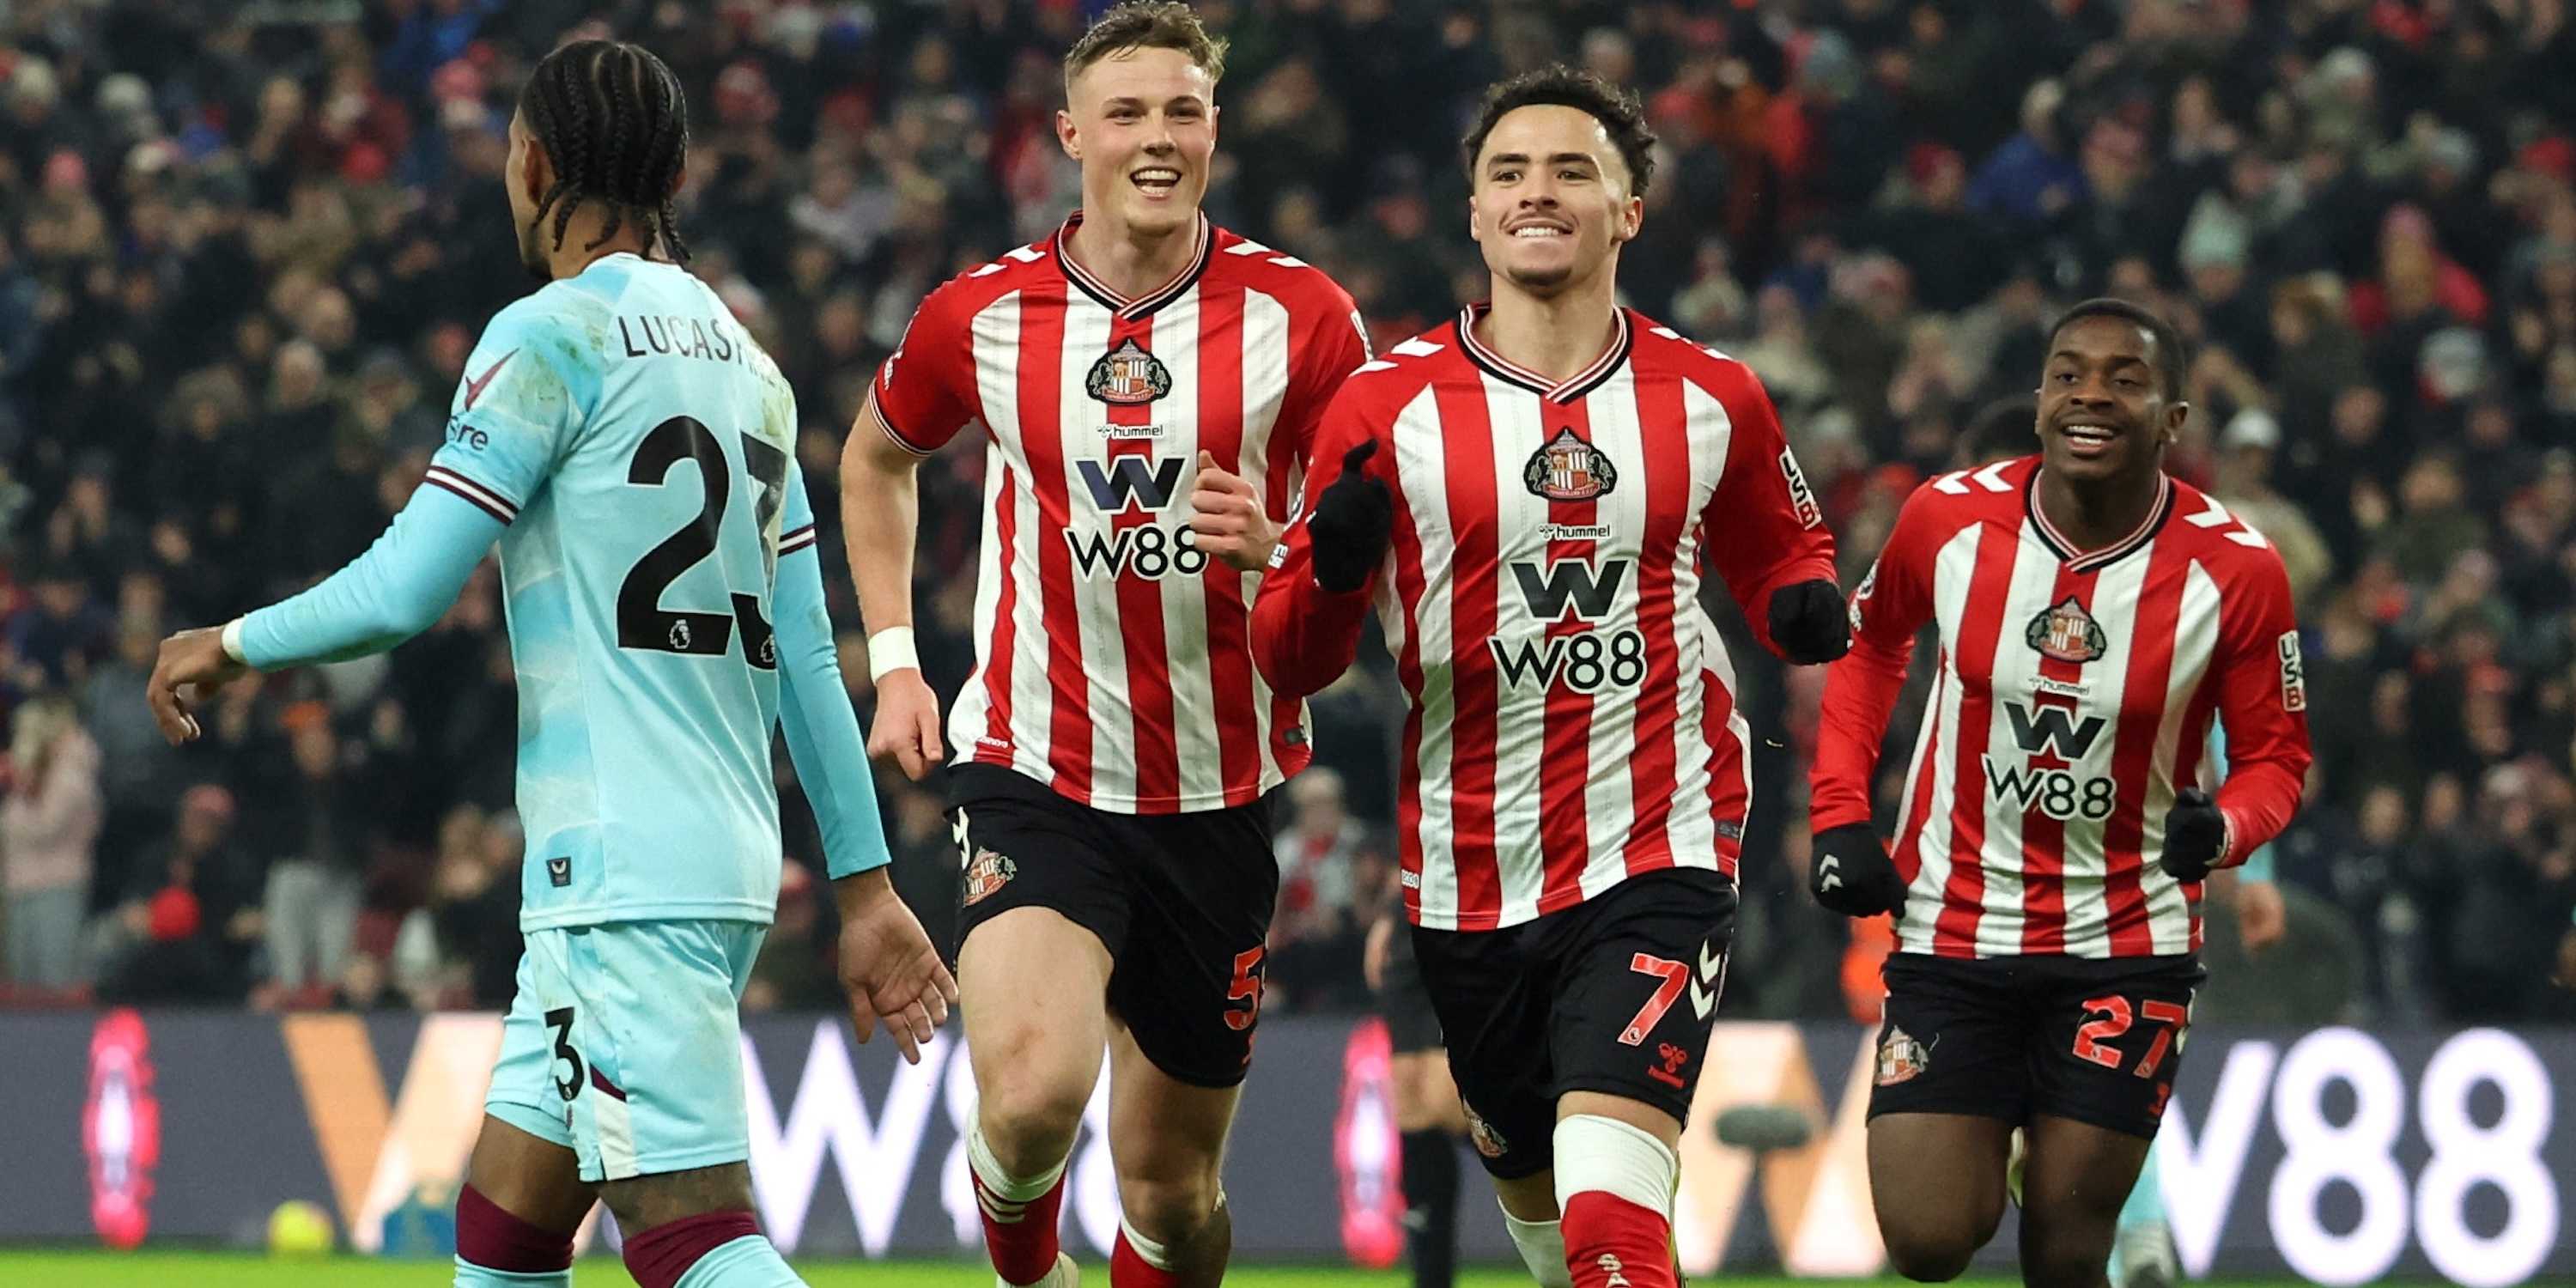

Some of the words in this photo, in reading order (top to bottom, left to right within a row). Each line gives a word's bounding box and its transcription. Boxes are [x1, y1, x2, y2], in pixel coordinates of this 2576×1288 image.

[1114, 424, 1163, 437] hummel
[1067, 526, 1207, 578] W88
[1557, 524, 1610, 537] hummel
[1492, 630, 1643, 690] W88
[1984, 756, 2113, 818] W88
[1224, 945, 1264, 1030] 5
[1617, 952, 1690, 1046] 7
[544, 1006, 585, 1102] 3
[2073, 995, 2186, 1078] 27
